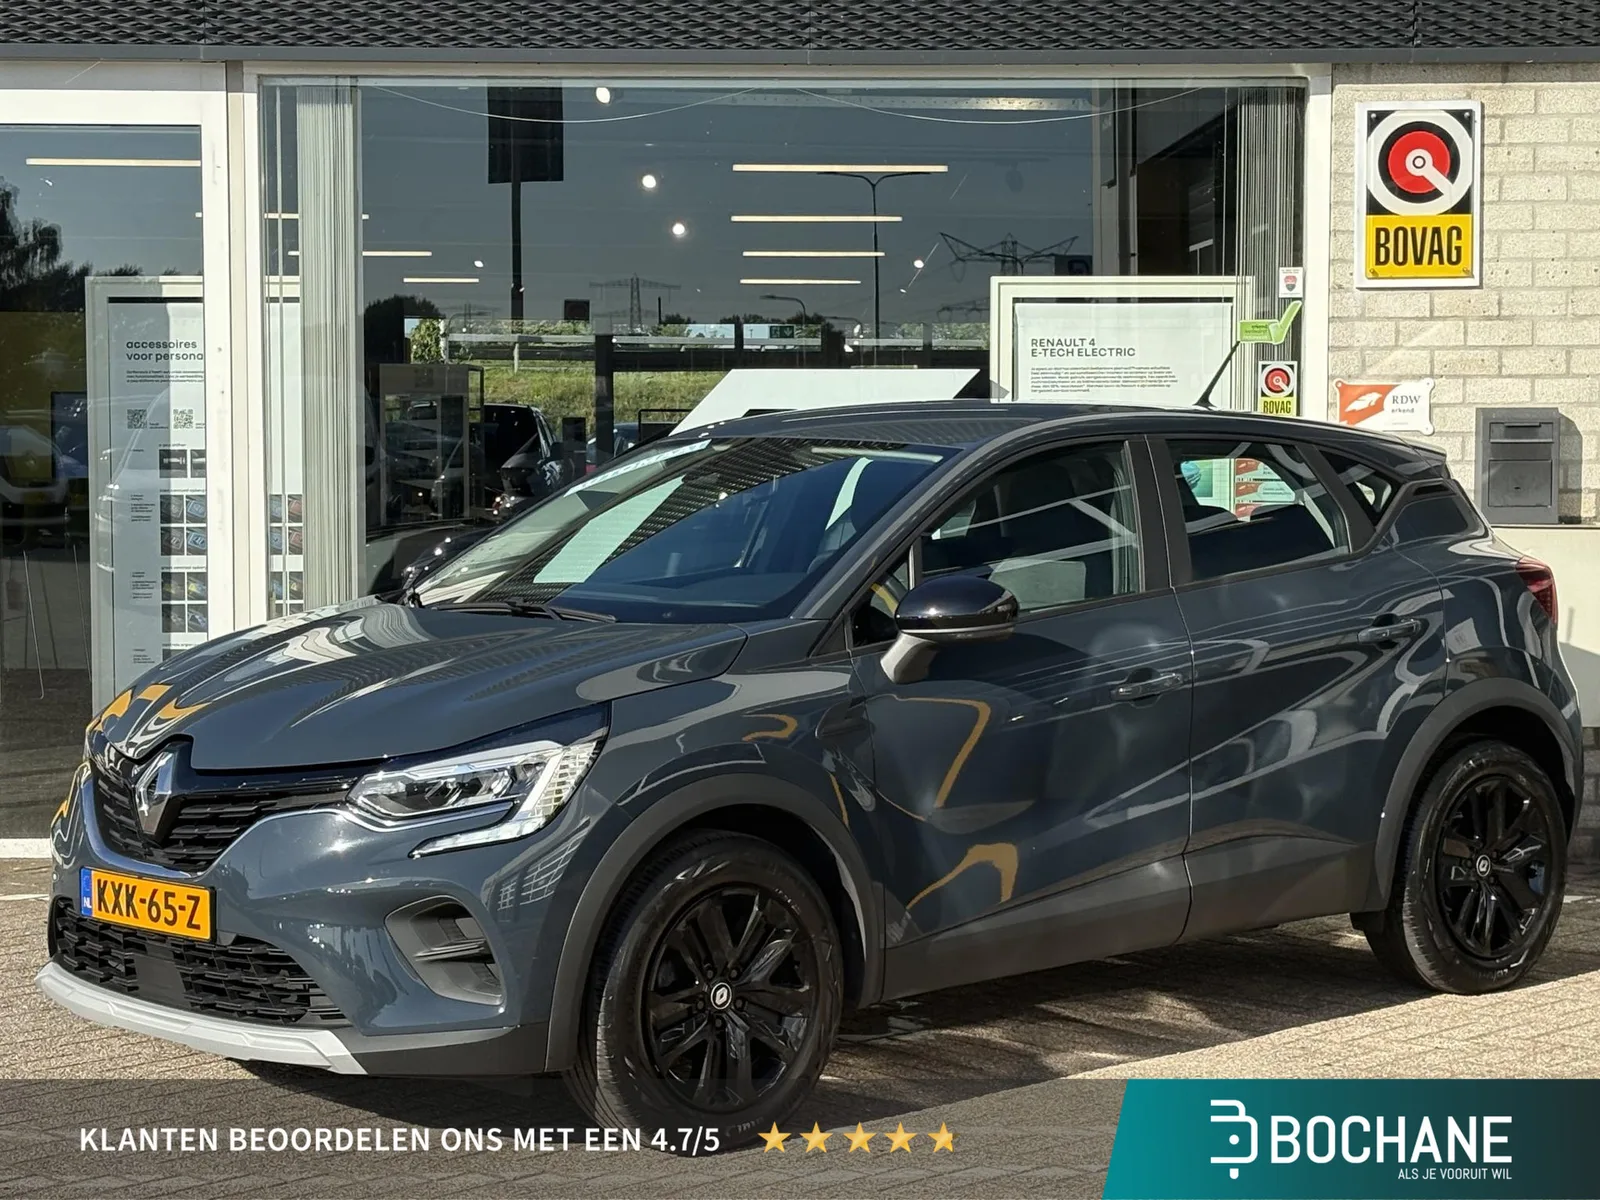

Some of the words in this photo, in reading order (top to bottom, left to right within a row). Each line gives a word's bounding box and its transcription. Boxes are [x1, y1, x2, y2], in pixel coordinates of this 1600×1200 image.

[1375, 226, 1462, 266] BOVAG
[126, 339, 197, 349] accessoires
[1031, 338, 1086, 347] RENAULT
[1088, 338, 1096, 347] 4
[1031, 348, 1074, 357] E-TECH
[1077, 348, 1136, 357] ELECTRIC
[155, 353, 203, 363] persona
[1392, 395, 1420, 405] RDW
[1263, 400, 1292, 414] BOVAG
[83, 897, 92, 909] NL
[97, 879, 201, 930] KXK-65-Z
